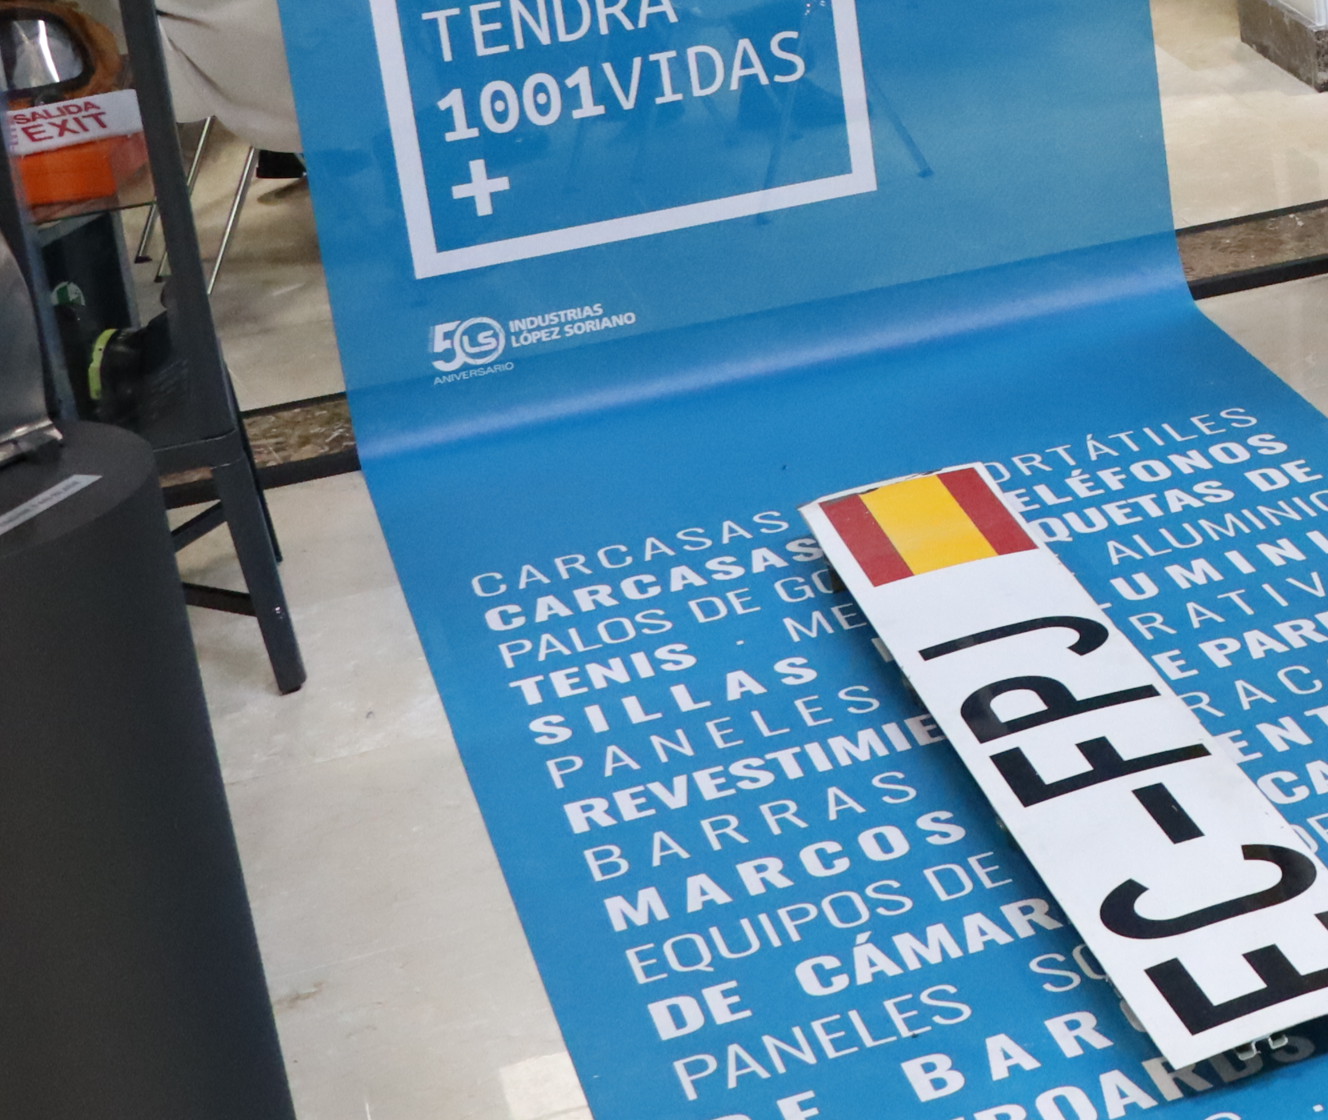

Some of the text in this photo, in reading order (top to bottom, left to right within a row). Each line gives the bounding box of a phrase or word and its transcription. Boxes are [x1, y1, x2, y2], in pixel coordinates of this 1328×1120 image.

[13, 100, 101, 125] SALIDA
[21, 111, 107, 143] EXIT
[432, 360, 515, 386] ANIVERSARIO
[508, 302, 604, 334] INDUSTRIAS
[509, 324, 562, 350] LÓPEZ
[563, 311, 637, 340] SORIANO
[472, 407, 1257, 598] CARCASAS ORTÁTILES
[483, 432, 1290, 632] CARCASAS ELÉFONOS
[498, 458, 1326, 668] PALOS DE GO QUETAS DE
[509, 642, 697, 705] TENIS
[783, 603, 869, 644] ME
[528, 654, 818, 746] SILLAS
[546, 684, 881, 789] PANELES
[562, 712, 947, 835] REVESTIMIE
[1151, 648, 1200, 682] E
[583, 771, 917, 882] BARRAS
[602, 810, 966, 932] MARCOS
[625, 879, 914, 984] EQUIPOS
[923, 850, 1012, 902] DE
[647, 980, 753, 1041] DE
[795, 896, 1069, 1000] CÁMAR
[673, 984, 973, 1102] PANELES
[1028, 943, 1108, 993] SO
